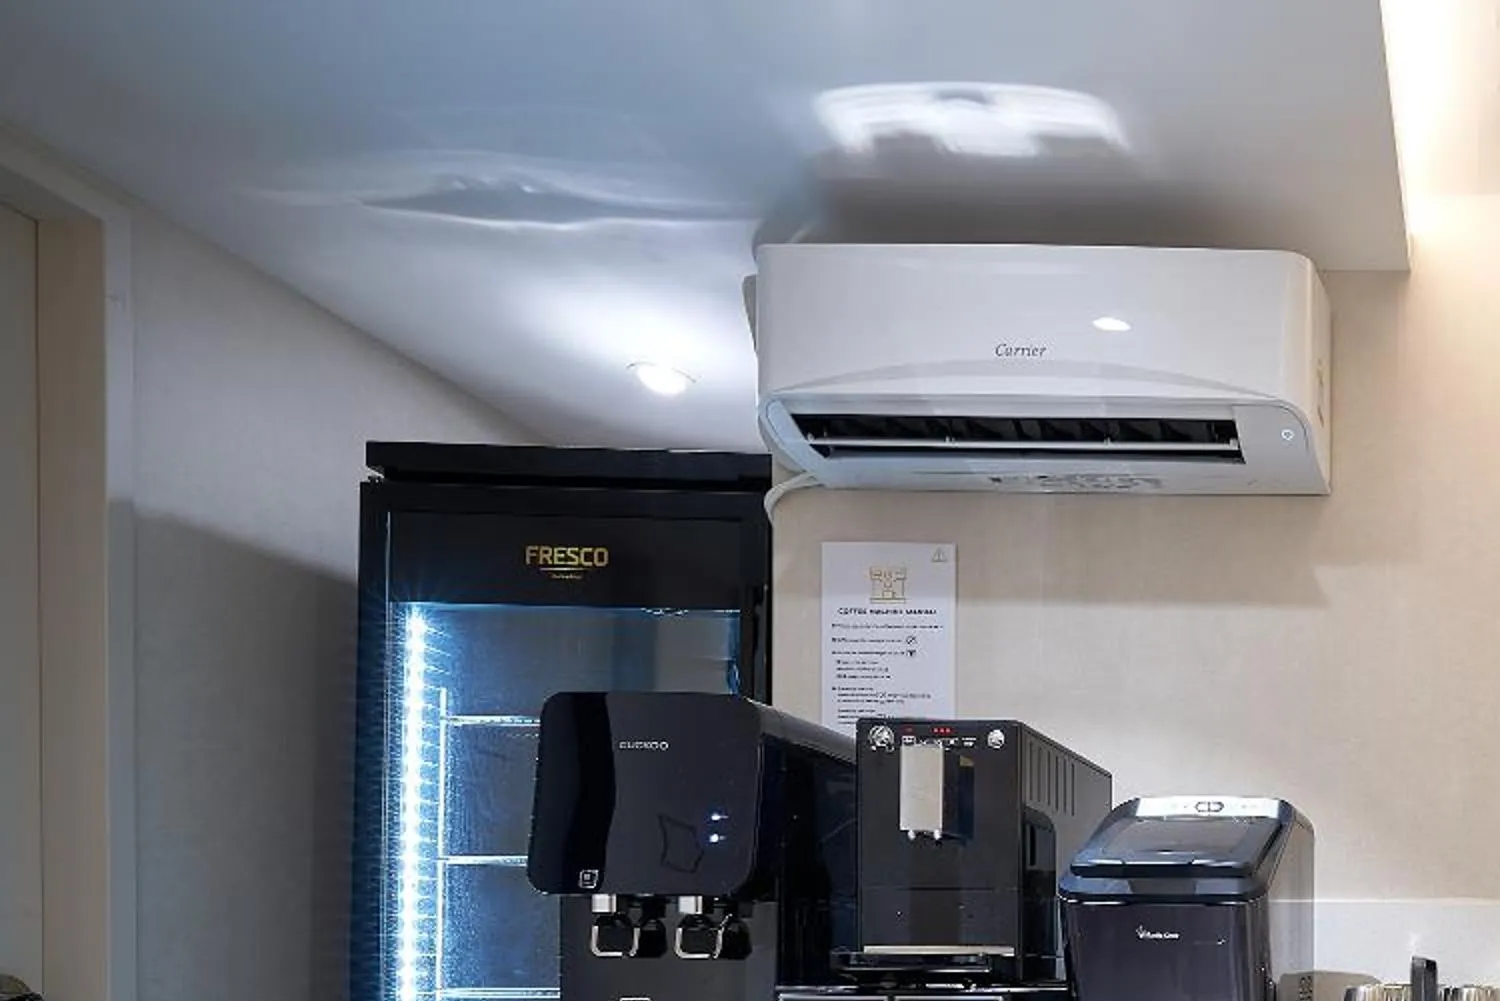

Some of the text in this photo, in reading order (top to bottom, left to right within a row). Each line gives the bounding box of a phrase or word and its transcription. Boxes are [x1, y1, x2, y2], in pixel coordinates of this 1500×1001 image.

[995, 343, 1047, 357] Carrier
[525, 545, 609, 567] FRESCO
[619, 741, 669, 750] CUCKOO
